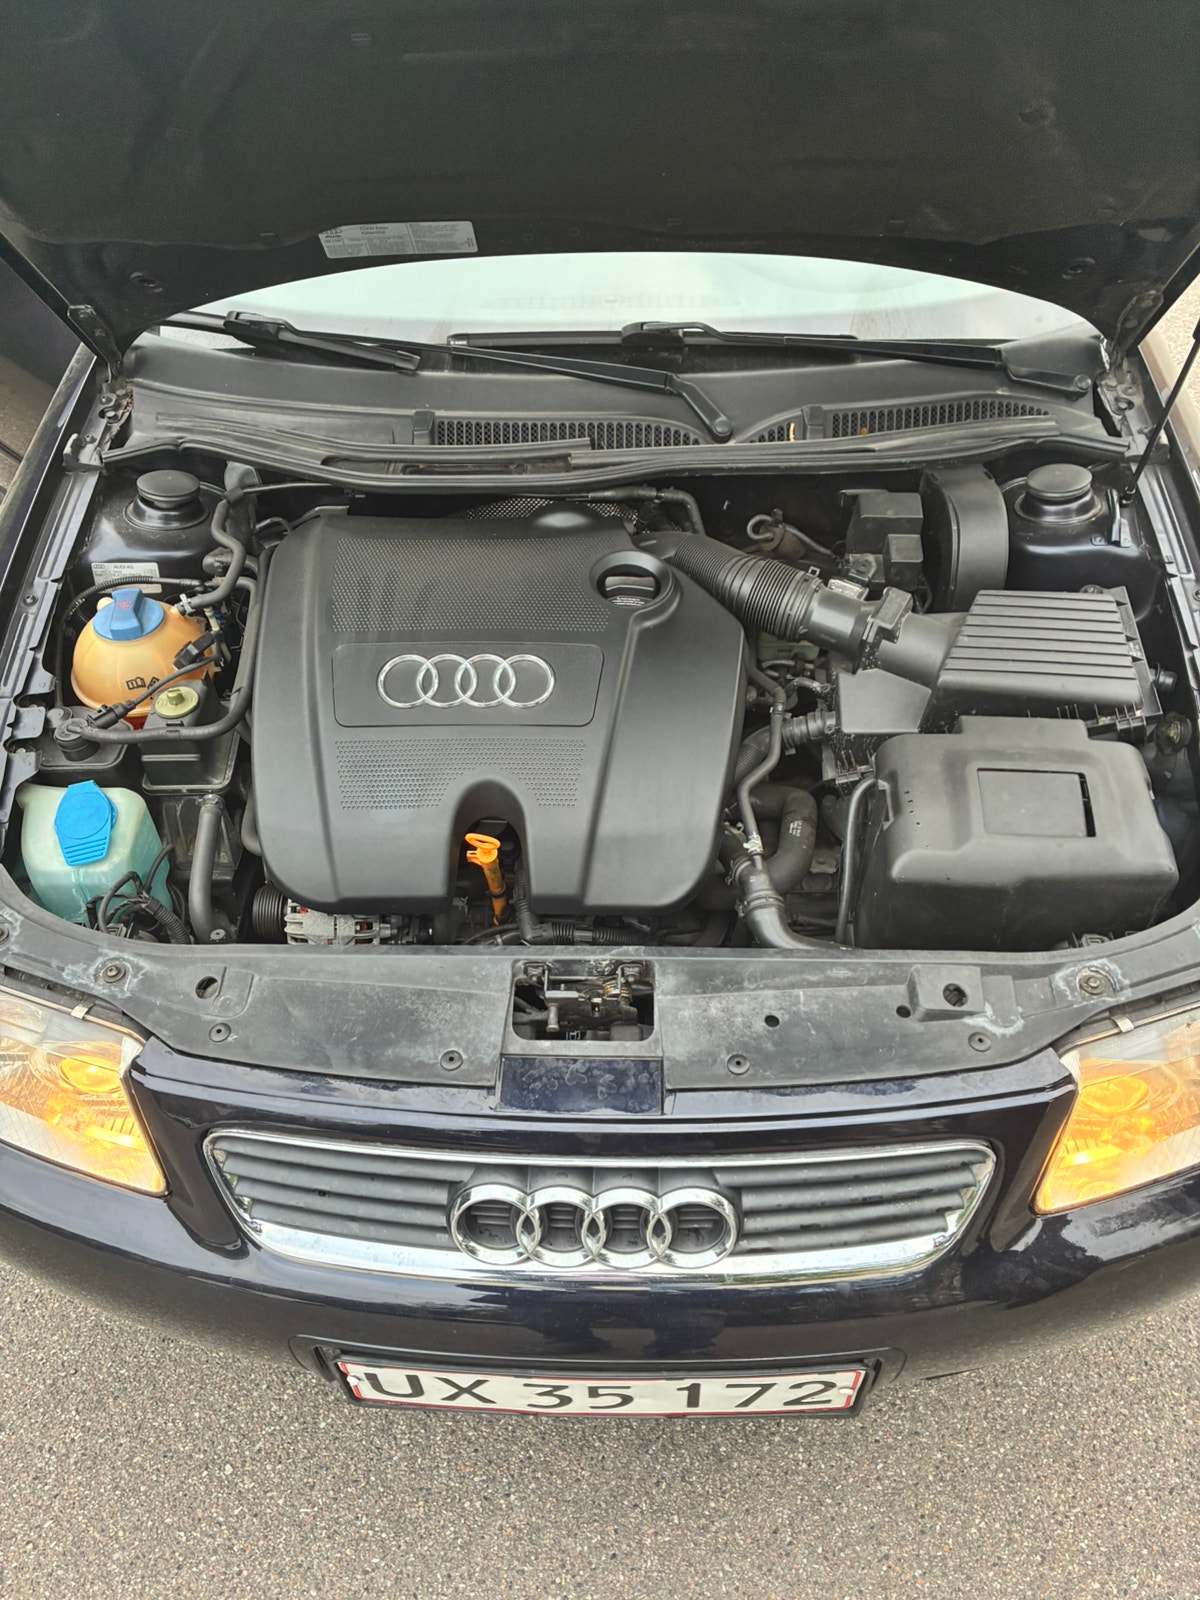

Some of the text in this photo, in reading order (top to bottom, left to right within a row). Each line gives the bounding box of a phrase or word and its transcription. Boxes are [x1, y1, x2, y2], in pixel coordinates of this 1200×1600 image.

[364, 1372, 838, 1409] UX 35 172
